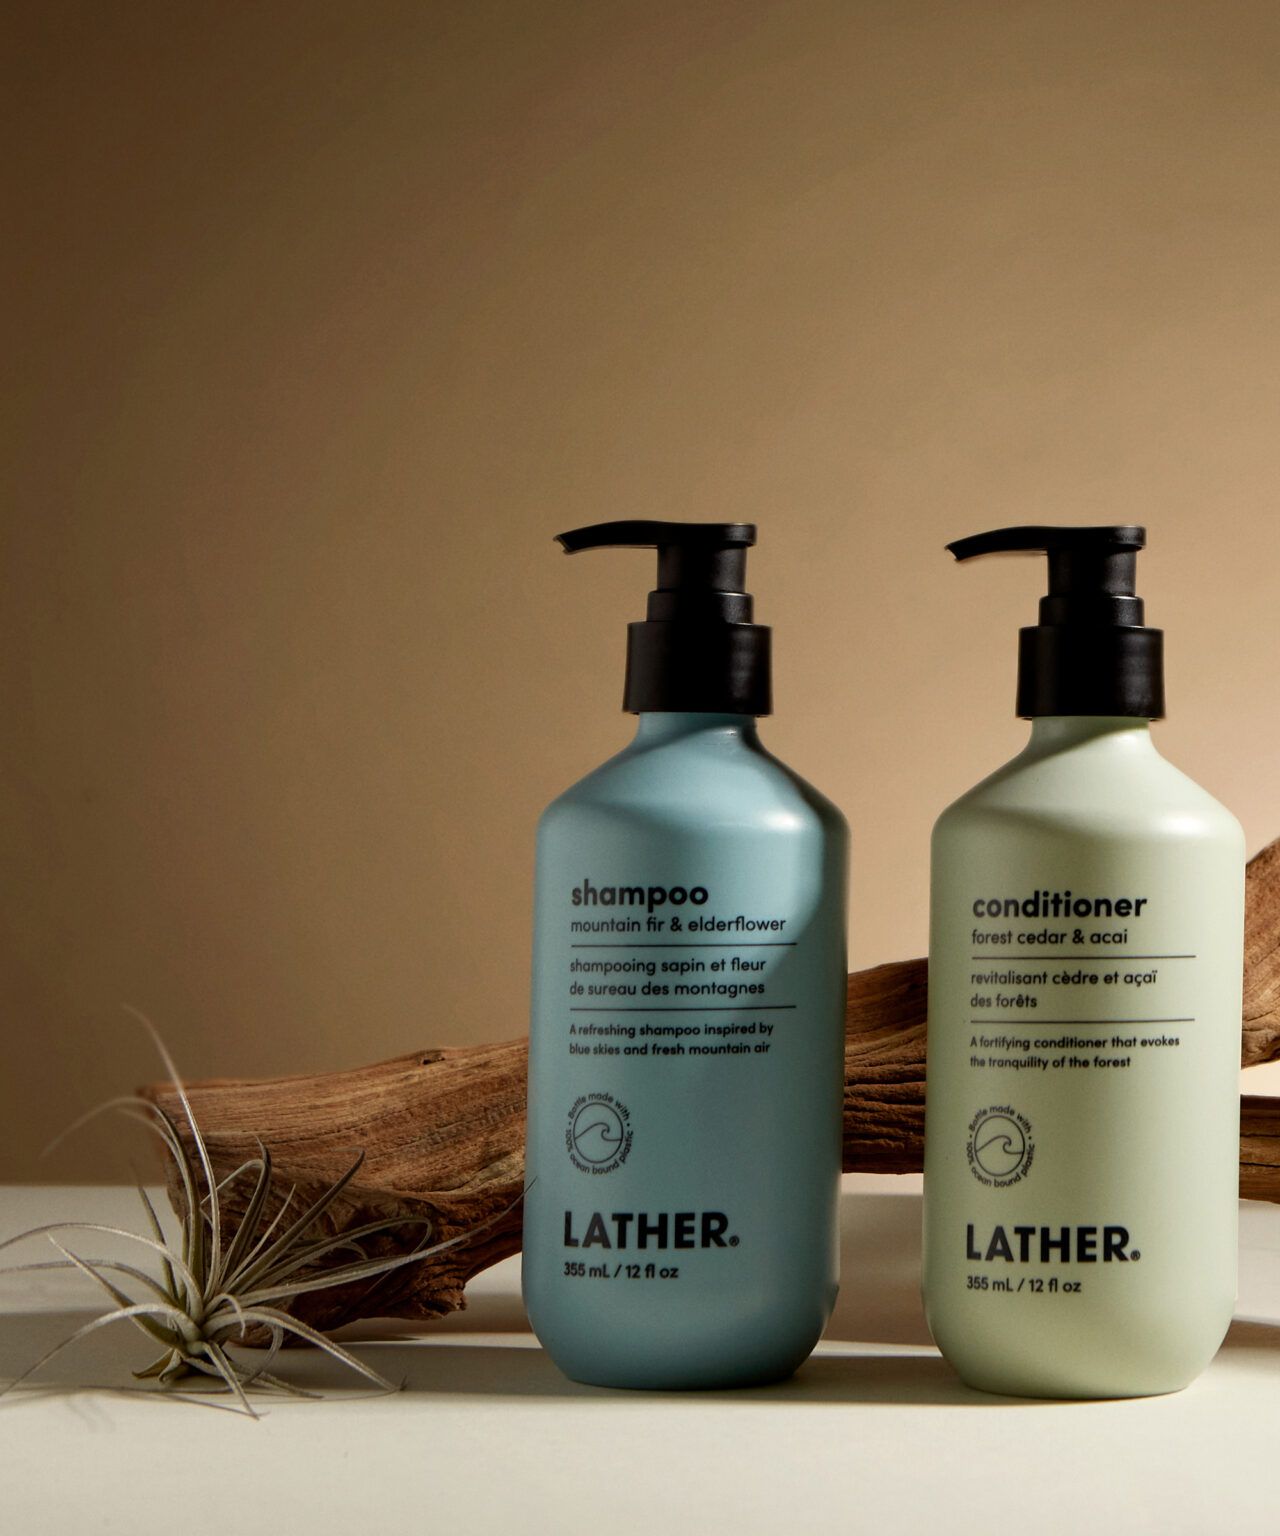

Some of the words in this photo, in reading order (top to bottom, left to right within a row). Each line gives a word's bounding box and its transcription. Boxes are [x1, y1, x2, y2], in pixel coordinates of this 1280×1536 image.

[571, 877, 709, 912] shampoo
[973, 890, 1147, 918] conditioner
[571, 917, 641, 932] mountain
[646, 916, 665, 932] fir
[670, 916, 682, 932] &
[688, 916, 786, 931] elderflower
[972, 929, 1013, 945] forest
[1017, 928, 1067, 945] cedar
[1072, 929, 1084, 944] &
[1090, 929, 1127, 944] acai
[570, 958, 656, 976] shampooing
[661, 958, 705, 976] sapin
[710, 959, 726, 972] et
[731, 957, 766, 971] fleur
[971, 970, 1048, 985] revitalisant
[1052, 970, 1099, 985] cèdre
[1103, 971, 1119, 984] et
[1124, 970, 1157, 987] açaï
[570, 981, 584, 995] de
[588, 985, 636, 995] sureau
[641, 981, 669, 995] des
[675, 982, 764, 998] montagnes
[970, 993, 992, 1008] des
[996, 993, 1037, 1008] forêts
[569, 1024, 576, 1035] A
[578, 1024, 636, 1039] refreshing
[640, 1024, 701, 1038] shampoo
[704, 1022, 756, 1038] inspired
[759, 1022, 773, 1036] by
[569, 1043, 591, 1055] blue
[593, 1043, 620, 1055] skies
[623, 1043, 648, 1055] and
[652, 1043, 685, 1055] fresh
[689, 1042, 751, 1055] mountain
[754, 1041, 770, 1053] air
[970, 1036, 977, 1047] A
[980, 1036, 1030, 1051] fortifying
[1034, 1036, 1108, 1048] conditioner
[1111, 1036, 1137, 1047] that
[1140, 1035, 1179, 1047] evokes
[970, 1056, 986, 1067] the
[989, 1056, 1049, 1071] tranquility
[1052, 1056, 1066, 1068] of
[1069, 1056, 1090, 1068] the
[1093, 1056, 1131, 1068] forest
[564, 1262, 586, 1277] 355
[589, 1263, 610, 1278] mL
[613, 1264, 622, 1278] /
[625, 1264, 641, 1279] 12
[645, 1263, 655, 1278] fl
[659, 1267, 679, 1279] oz
[967, 1275, 989, 1291] 355
[992, 1277, 1013, 1292] mL
[1017, 1278, 1025, 1292] /
[1029, 1279, 1043, 1293] 12
[1048, 1278, 1058, 1292] fl
[1062, 1282, 1081, 1293] oz
